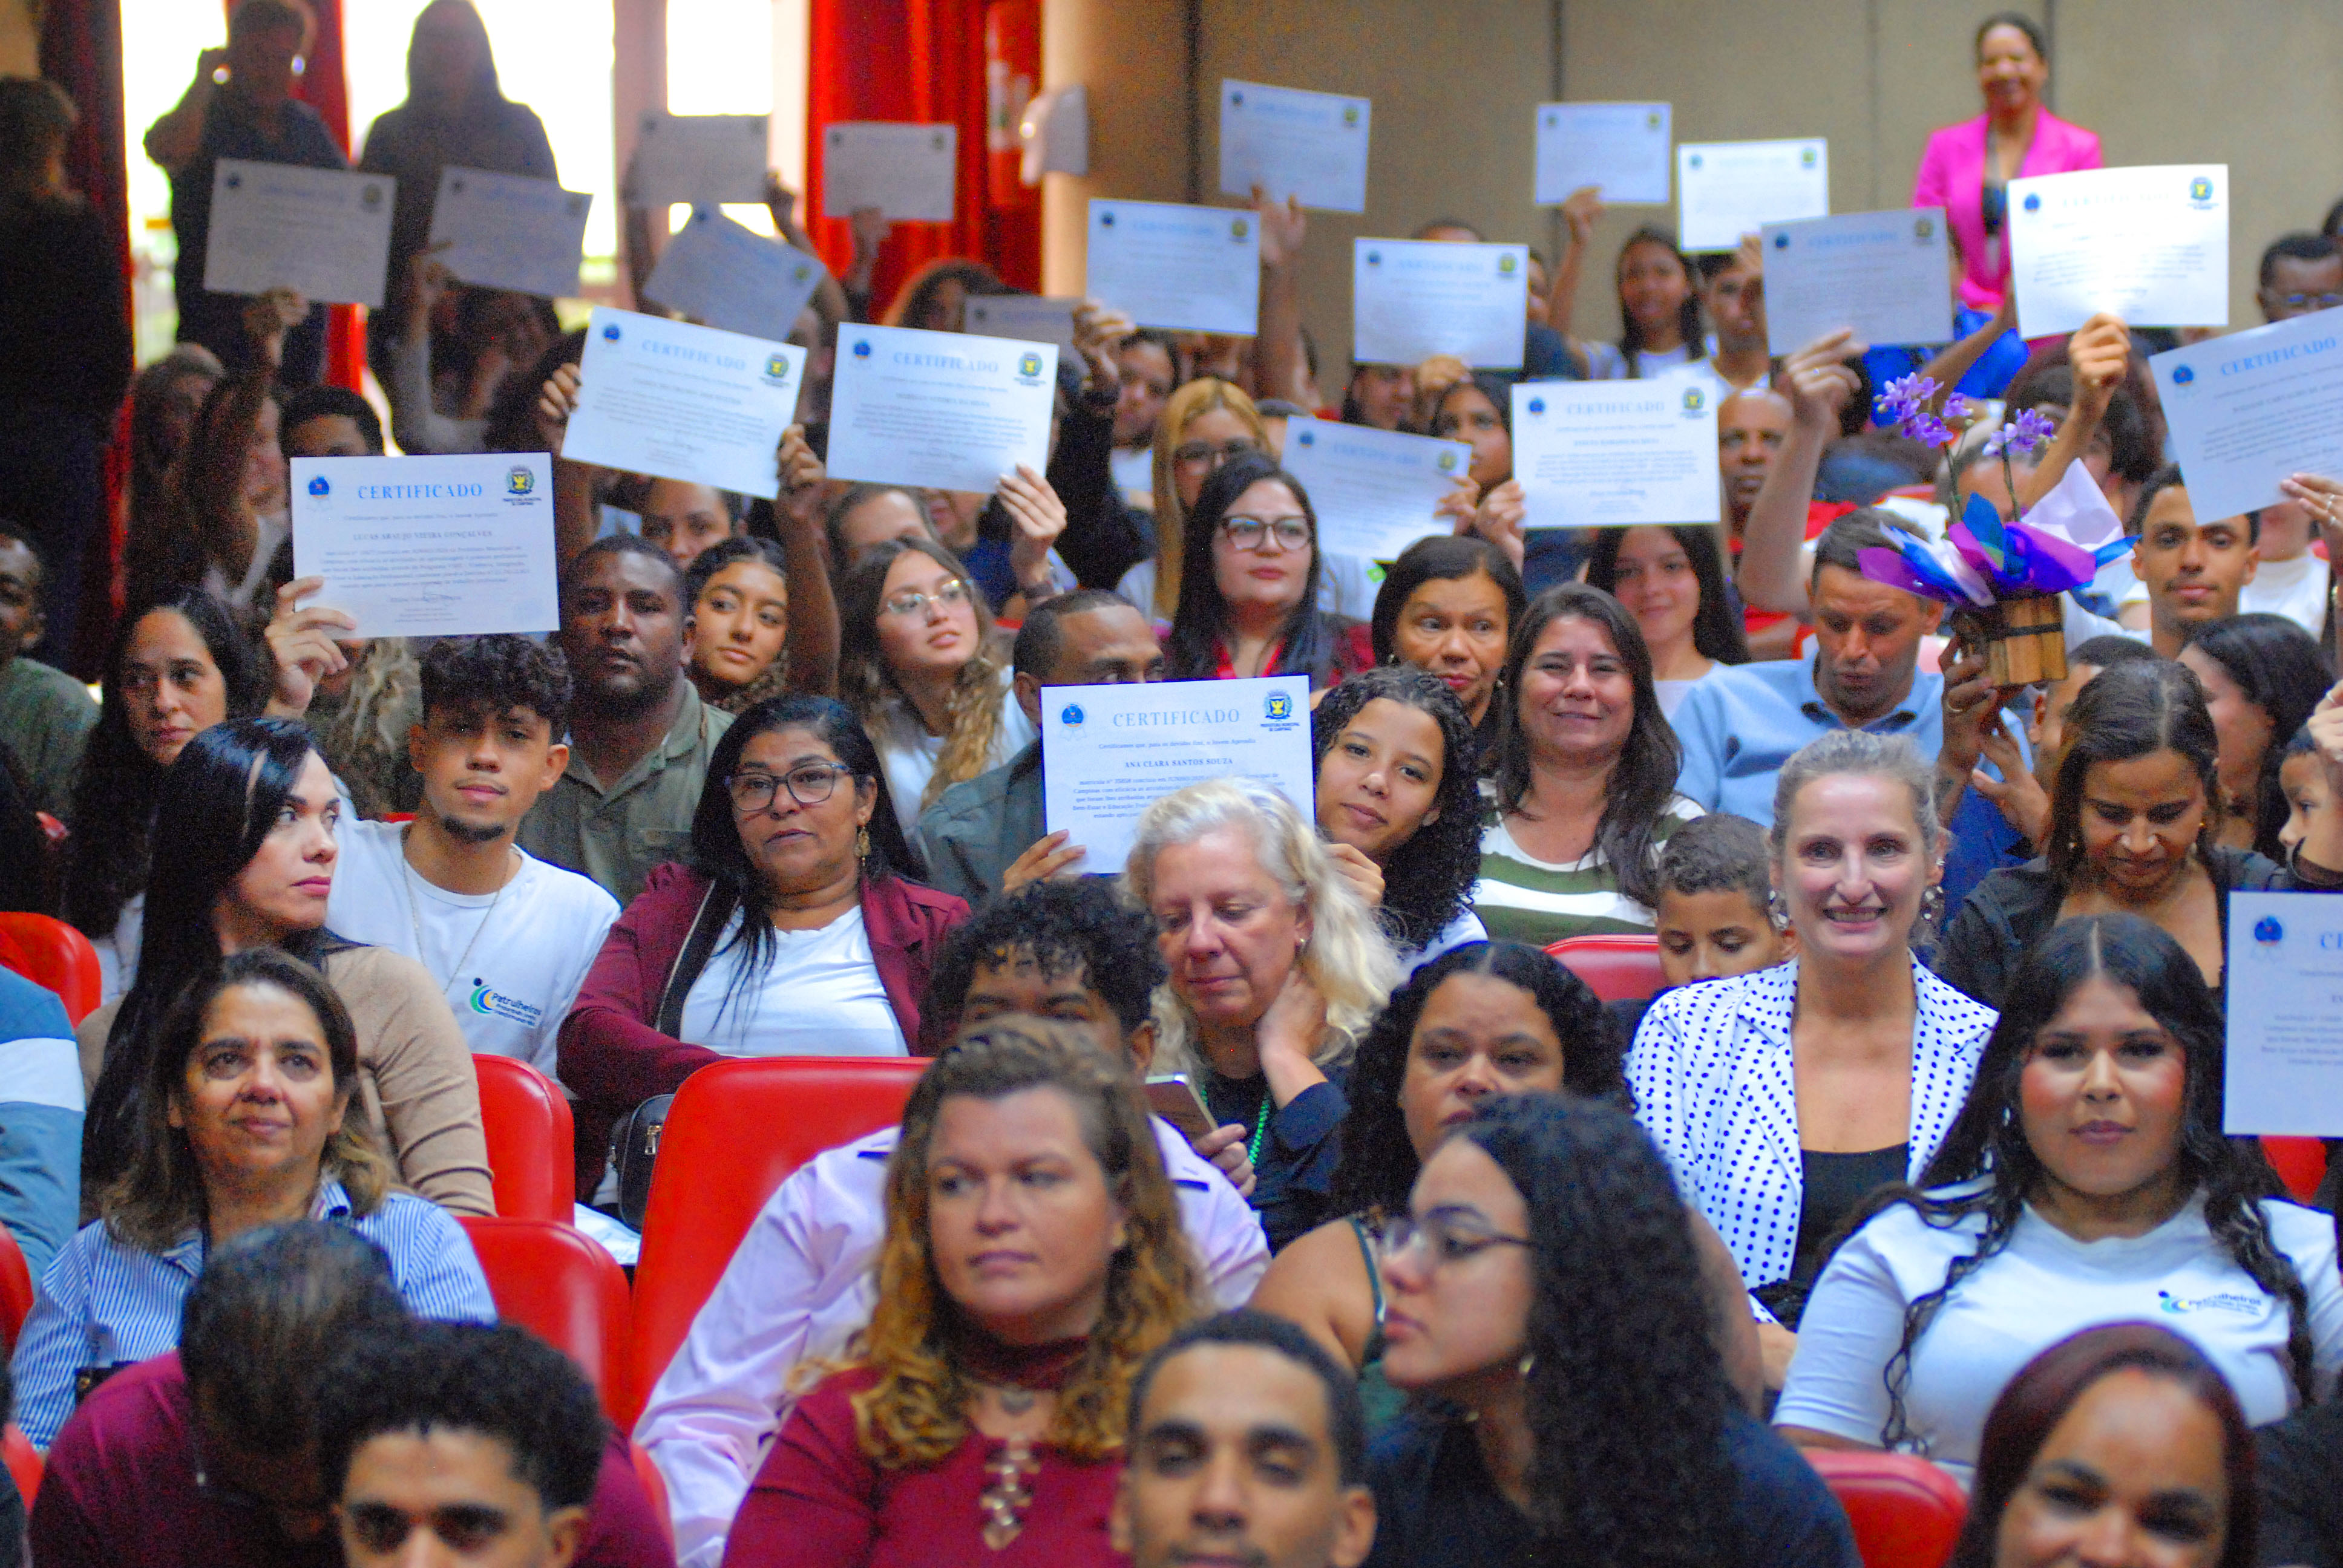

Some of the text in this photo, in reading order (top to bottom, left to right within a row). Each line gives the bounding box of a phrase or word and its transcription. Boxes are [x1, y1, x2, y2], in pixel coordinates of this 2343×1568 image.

[641, 339, 746, 371] CERTIFICADO
[893, 351, 998, 373] CERTIFICADO
[2221, 336, 2336, 376] CERTIFICADO
[1567, 401, 1665, 416] CERTIFICADO
[358, 483, 483, 499] CERTIFICADO
[1113, 709, 1240, 727] CERTIFICADO
[491, 993, 542, 1016] Patrulheiros
